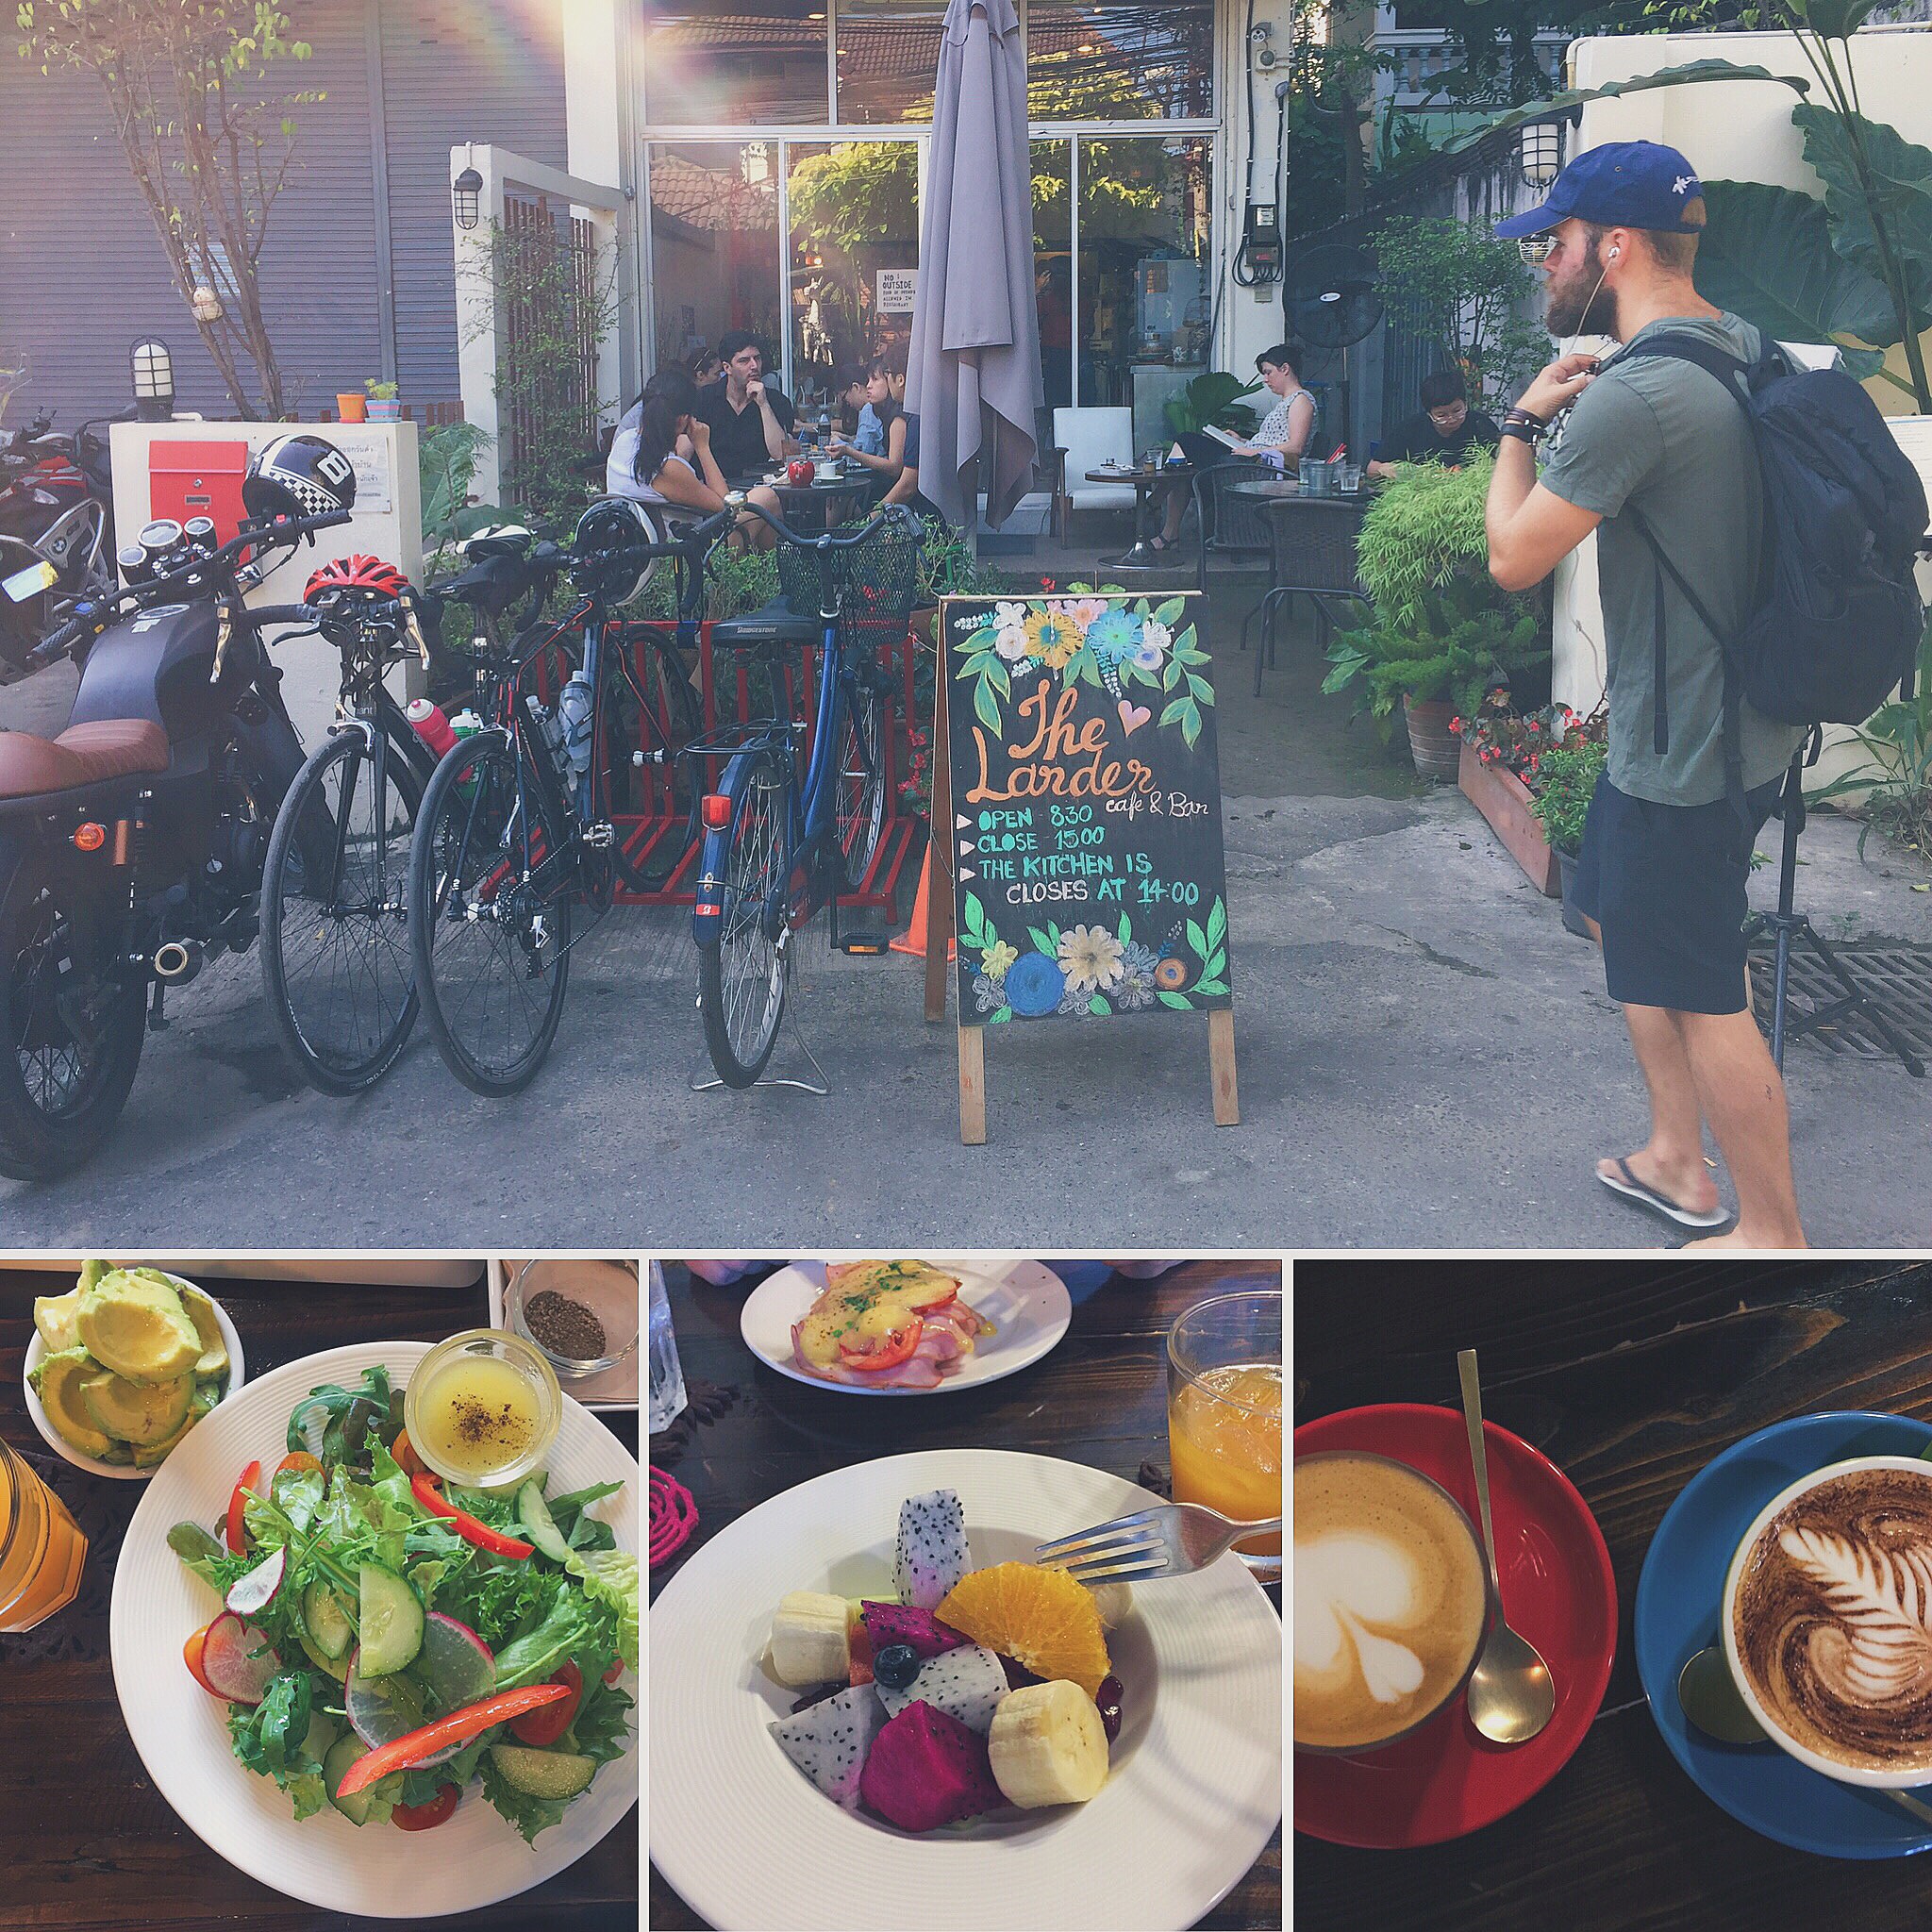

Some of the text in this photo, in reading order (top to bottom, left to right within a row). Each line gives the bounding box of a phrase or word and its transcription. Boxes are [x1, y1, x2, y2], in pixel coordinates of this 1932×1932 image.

[882, 280, 912, 290] OUTSIDE
[1008, 678, 1109, 760] The
[1149, 791, 1164, 816] &
[1167, 791, 1209, 818] Bar
[978, 807, 1033, 831] OPEN
[977, 832, 1039, 853] CLOSE
[978, 852, 1154, 880] THE KITCHEN IS
[1006, 878, 1089, 905] CLOSES
[1097, 877, 1127, 901] AT
